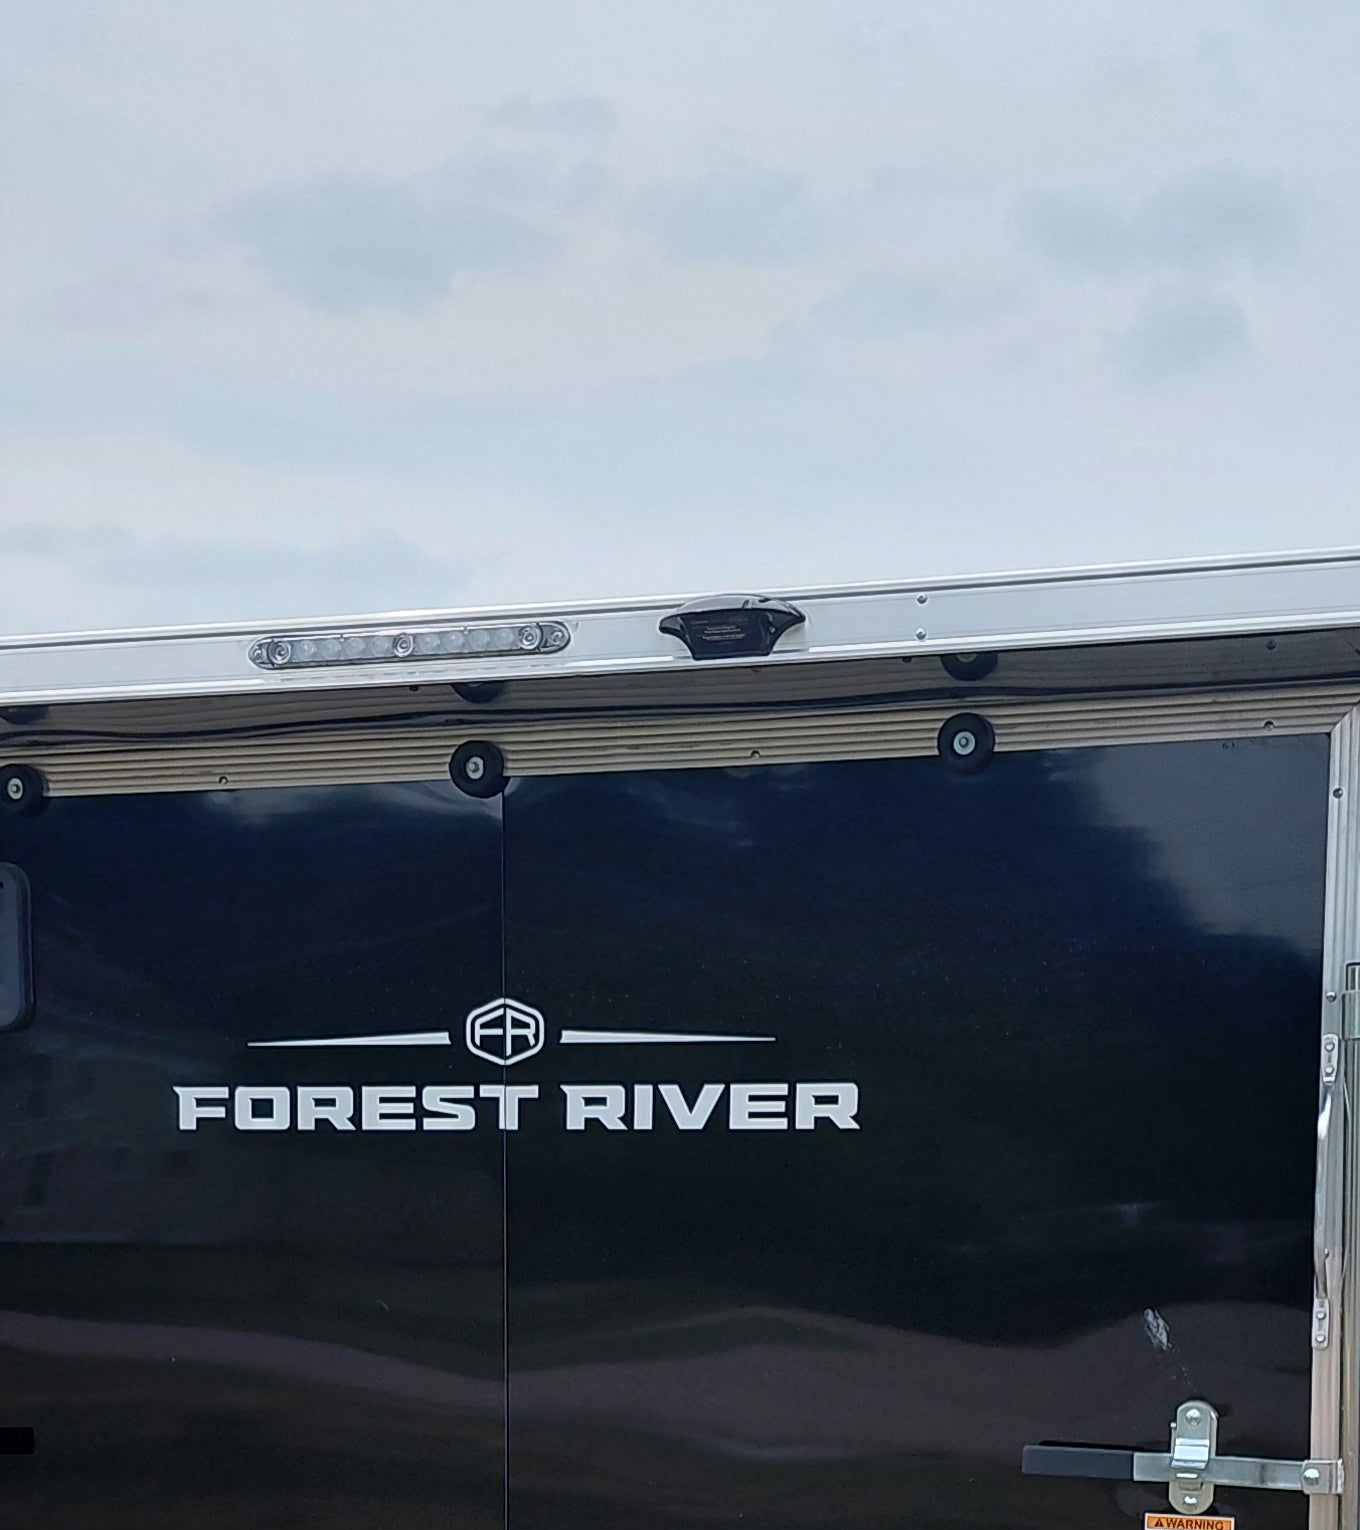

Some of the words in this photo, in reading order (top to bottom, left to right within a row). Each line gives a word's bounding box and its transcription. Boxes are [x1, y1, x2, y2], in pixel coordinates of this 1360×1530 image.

[474, 1007, 537, 1056] FR
[173, 1084, 539, 1131] FOREST
[560, 1083, 860, 1131] RIVER
[1166, 1518, 1224, 1530] WARNING
